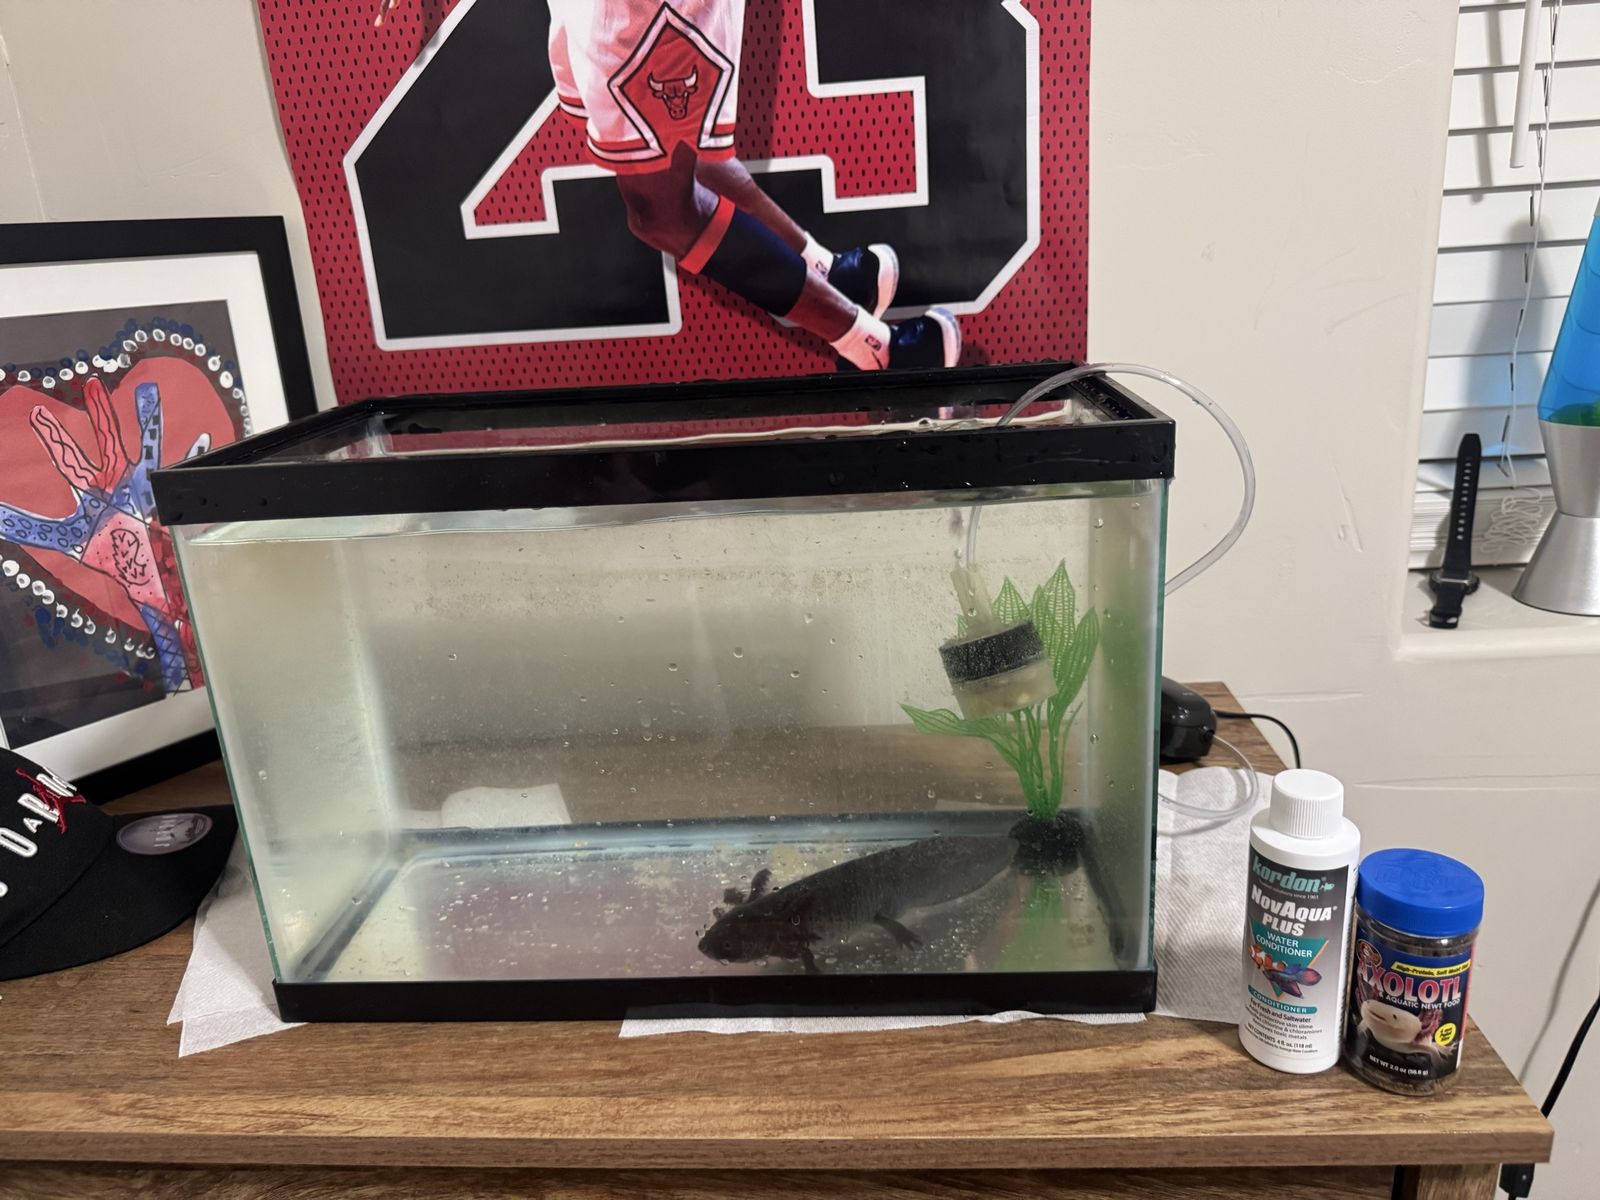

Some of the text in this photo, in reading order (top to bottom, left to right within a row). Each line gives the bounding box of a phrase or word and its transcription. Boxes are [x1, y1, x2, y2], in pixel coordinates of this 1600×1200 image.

[1252, 855, 1321, 893] kordon
[1262, 912, 1305, 937] PLUS
[1256, 934, 1313, 958] CONDITIONER
[1267, 931, 1299, 948] WATER
[1253, 991, 1307, 1014] CONDITIONER
[1258, 1002, 1271, 1014] Fresh
[1272, 1011, 1282, 1019] and
[1283, 1015, 1311, 1023] Saltwater
[1385, 995, 1418, 1008] AQUATIC
[1444, 999, 1461, 1008] FOOD
